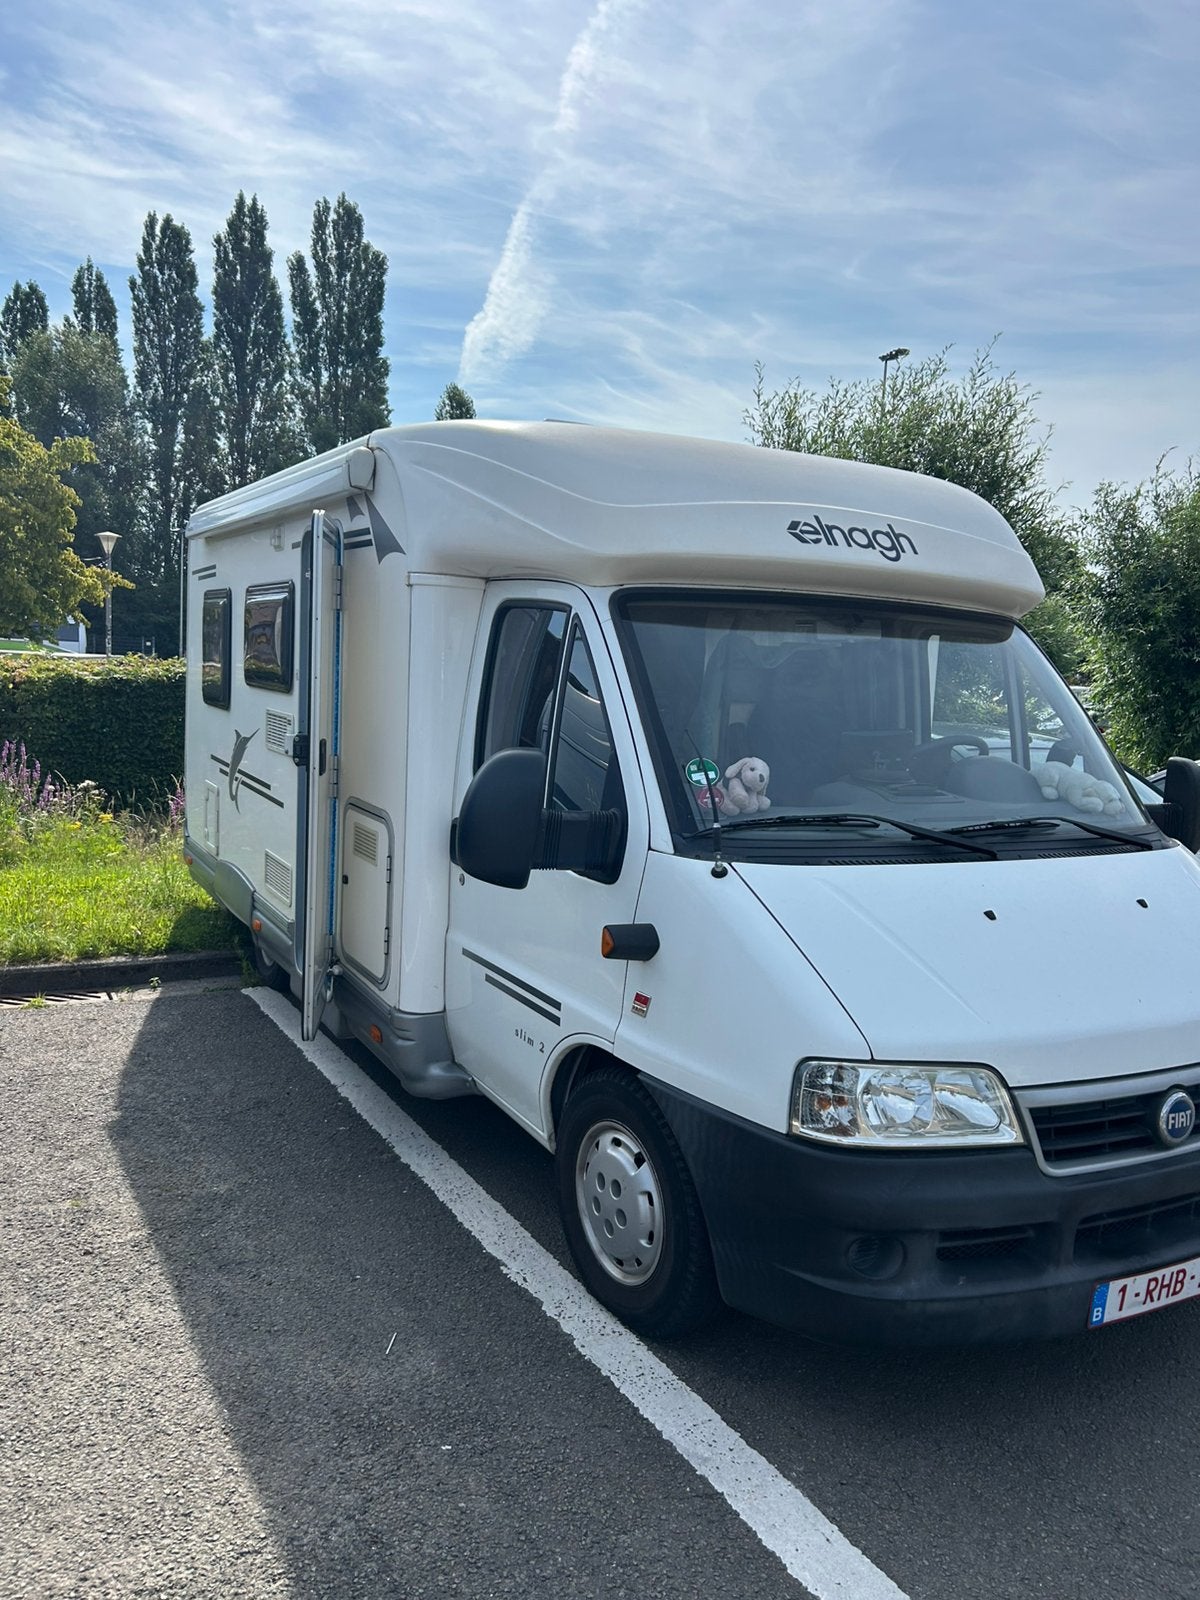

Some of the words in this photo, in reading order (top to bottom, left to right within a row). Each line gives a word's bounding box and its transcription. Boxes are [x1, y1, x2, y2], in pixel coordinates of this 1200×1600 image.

[788, 515, 919, 562] elnagh
[514, 1028, 535, 1047] slim
[538, 1041, 546, 1054] 2
[1168, 1109, 1192, 1130] FIAT
[1117, 1267, 1200, 1312] 1-RHB-
[1092, 1307, 1103, 1322] B
